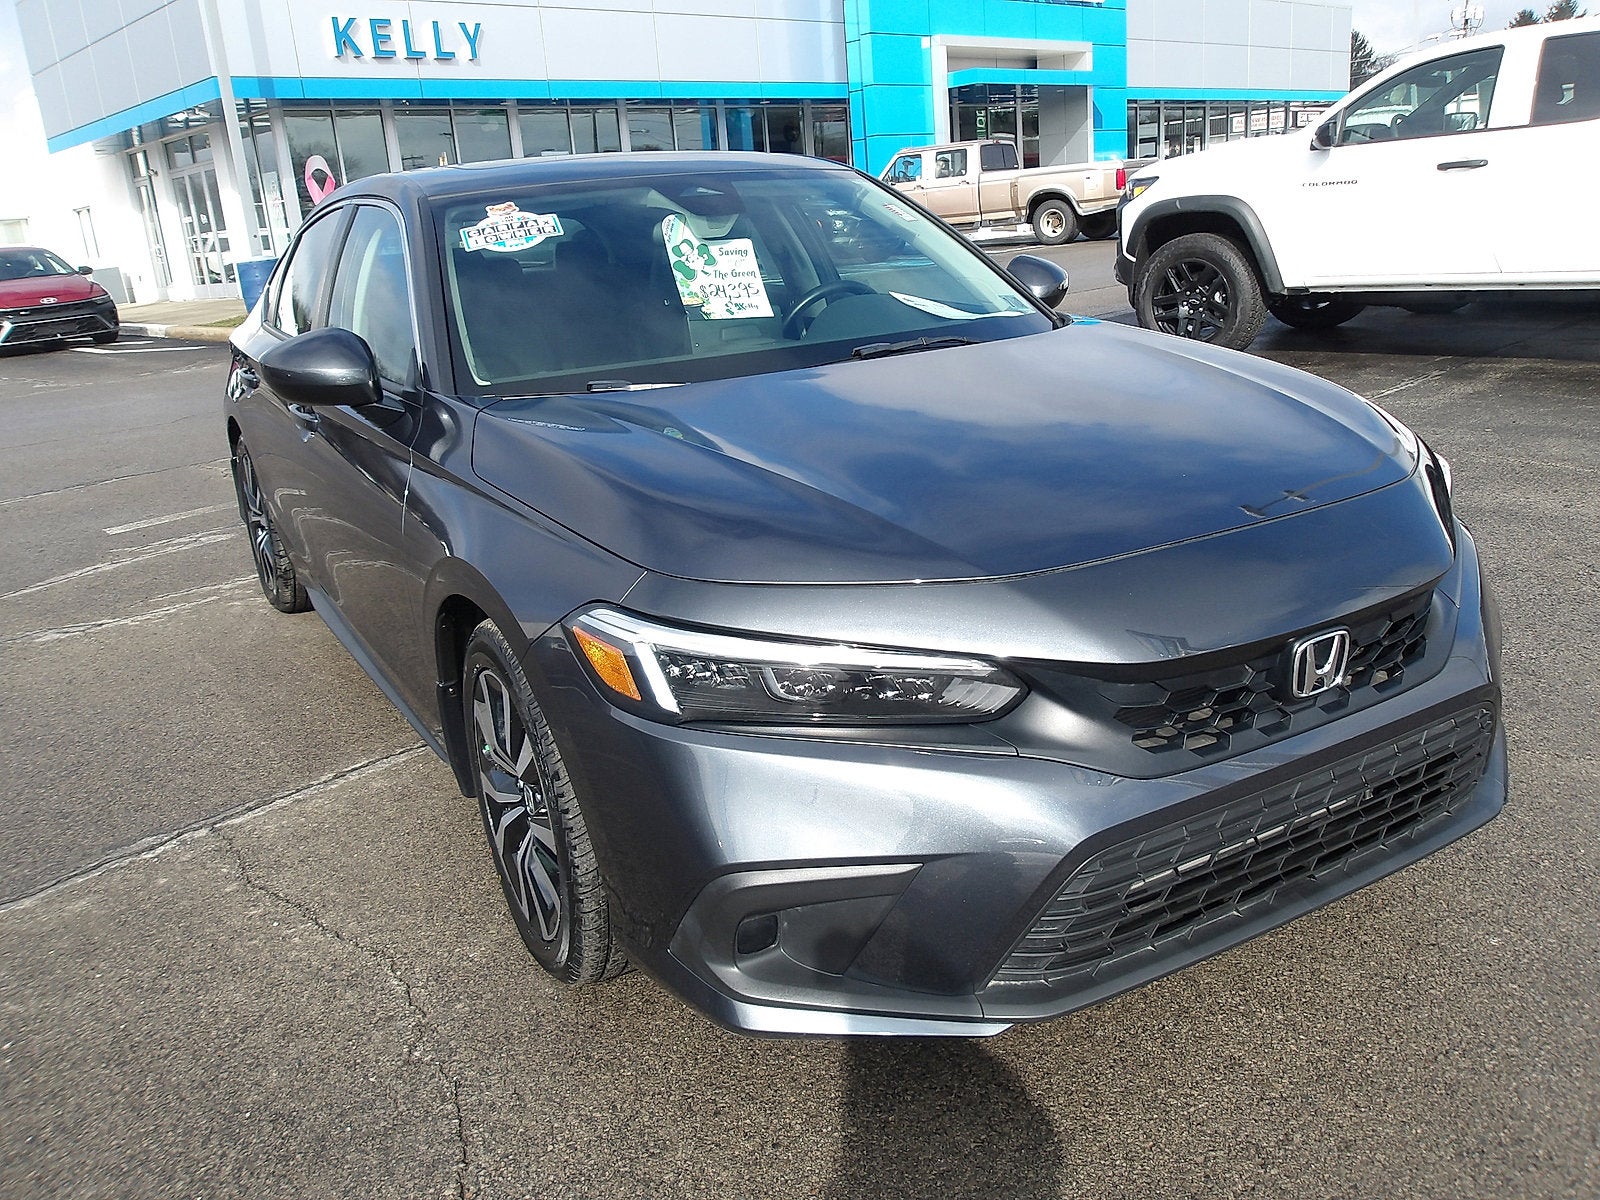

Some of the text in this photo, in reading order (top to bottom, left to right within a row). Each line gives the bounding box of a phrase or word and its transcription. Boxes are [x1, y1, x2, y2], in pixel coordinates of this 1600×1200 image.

[331, 16, 482, 62] KELLY
[1302, 179, 1358, 187] COLORADO
[718, 247, 749, 258] Saving
[713, 268, 757, 281] The Green
[699, 282, 760, 301] $24,395
